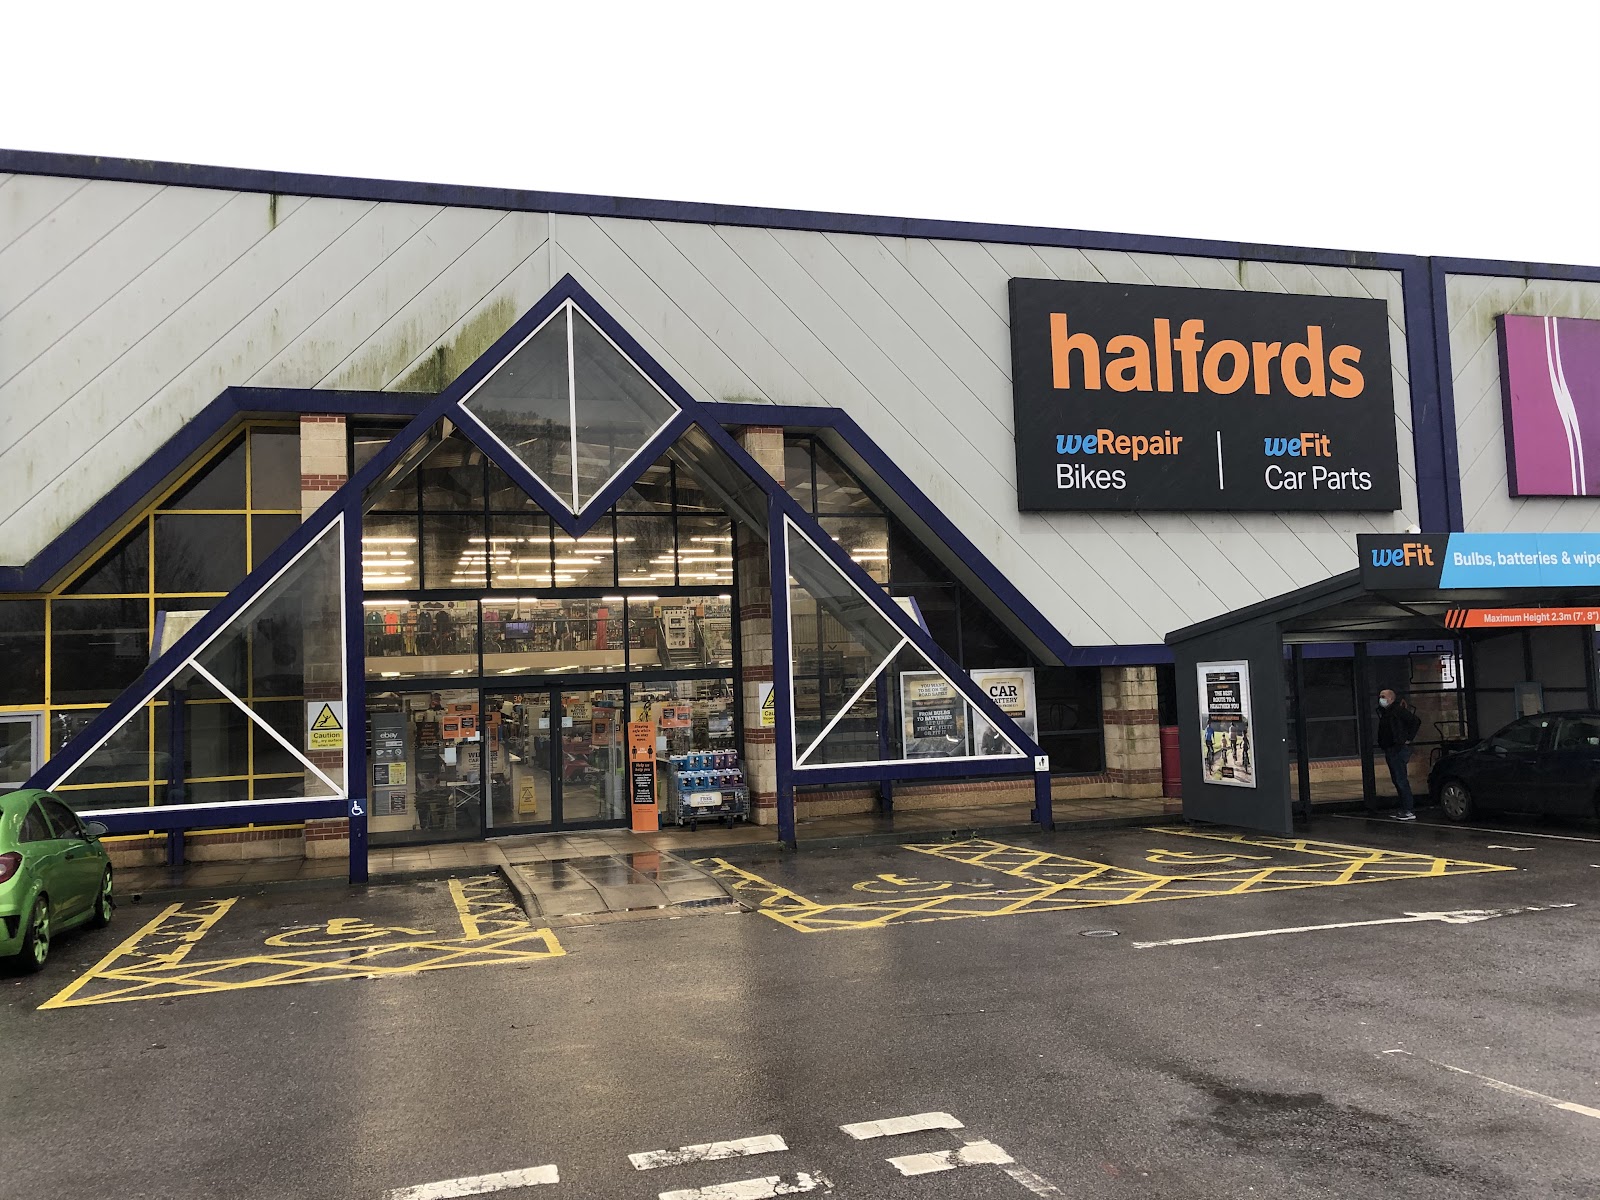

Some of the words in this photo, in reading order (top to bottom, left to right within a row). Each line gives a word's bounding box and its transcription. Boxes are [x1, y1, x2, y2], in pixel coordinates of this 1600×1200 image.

[1049, 312, 1365, 398] halfords
[1055, 429, 1183, 461] weRepair
[1264, 432, 1331, 458] weFit
[1056, 463, 1127, 490] Bikes
[1264, 465, 1306, 490] Car
[1312, 465, 1372, 490] Parts
[1371, 543, 1435, 567] weFit
[1453, 552, 1496, 567] Bulbs,
[1498, 551, 1557, 565] batteries
[1561, 551, 1572, 565] &
[1483, 613, 1522, 623] Maximum
[1523, 612, 1550, 624] Height
[1551, 612, 1572, 621] 2.3m
[990, 686, 1018, 696] CAR
